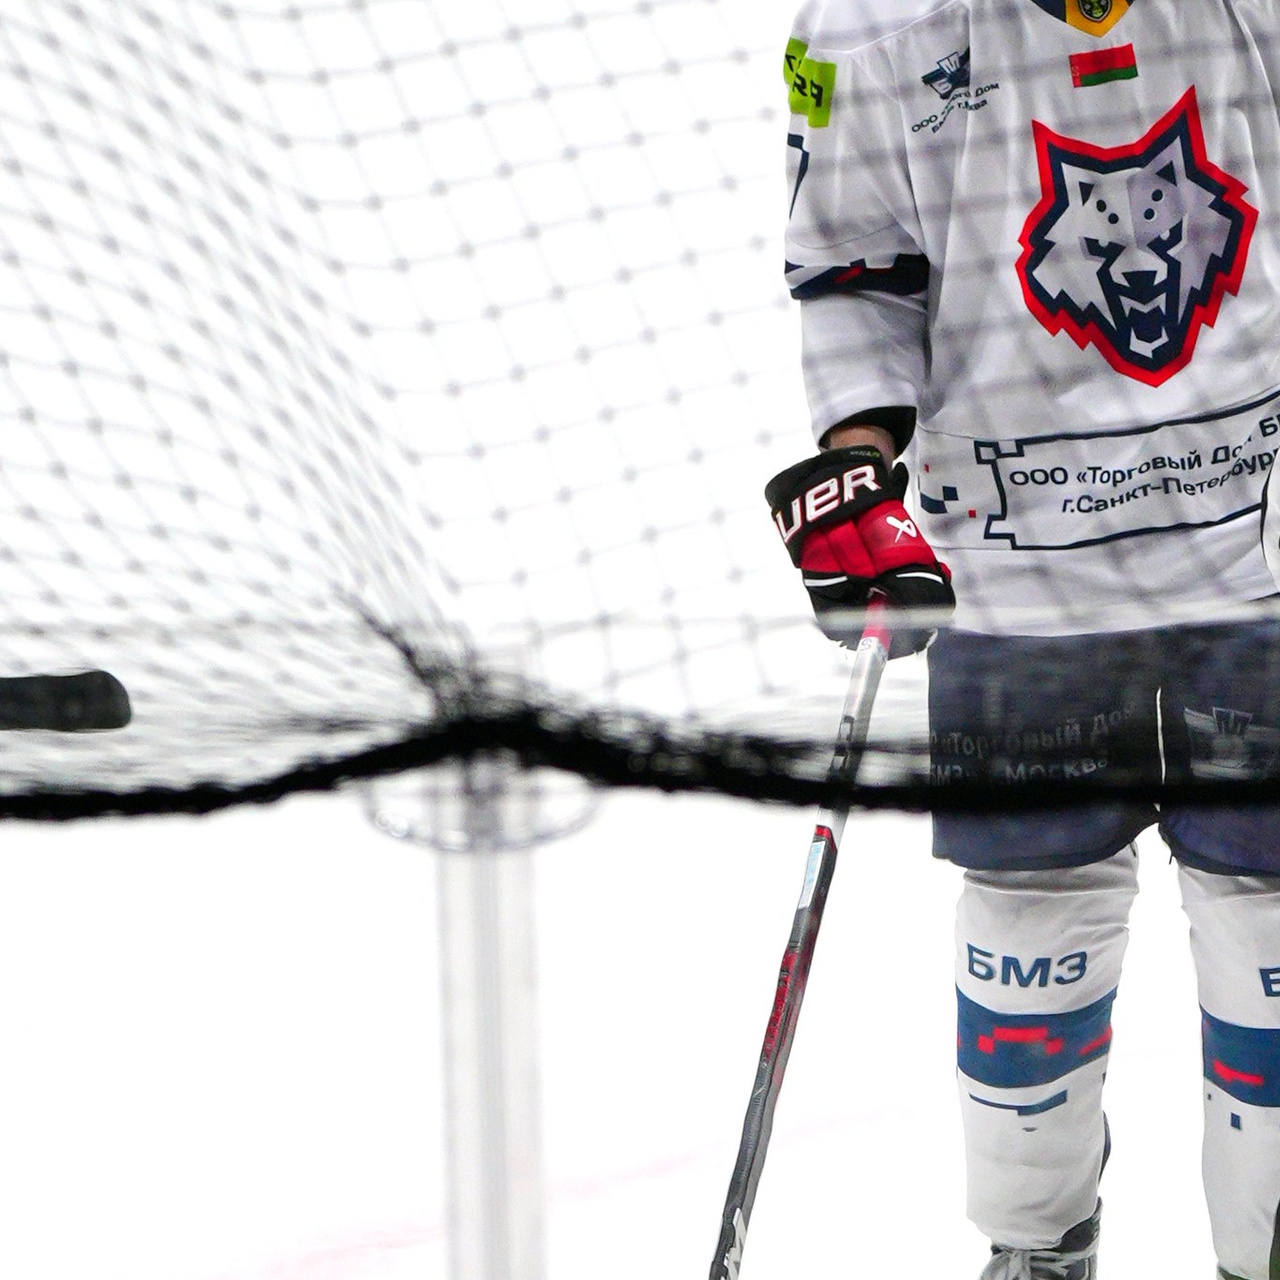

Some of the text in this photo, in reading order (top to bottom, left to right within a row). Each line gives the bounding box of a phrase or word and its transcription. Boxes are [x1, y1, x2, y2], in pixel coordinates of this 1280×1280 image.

[1009, 467, 1069, 486] ООО
[1076, 449, 1202, 487] «Торговый
[966, 942, 1088, 988] БМЗ
